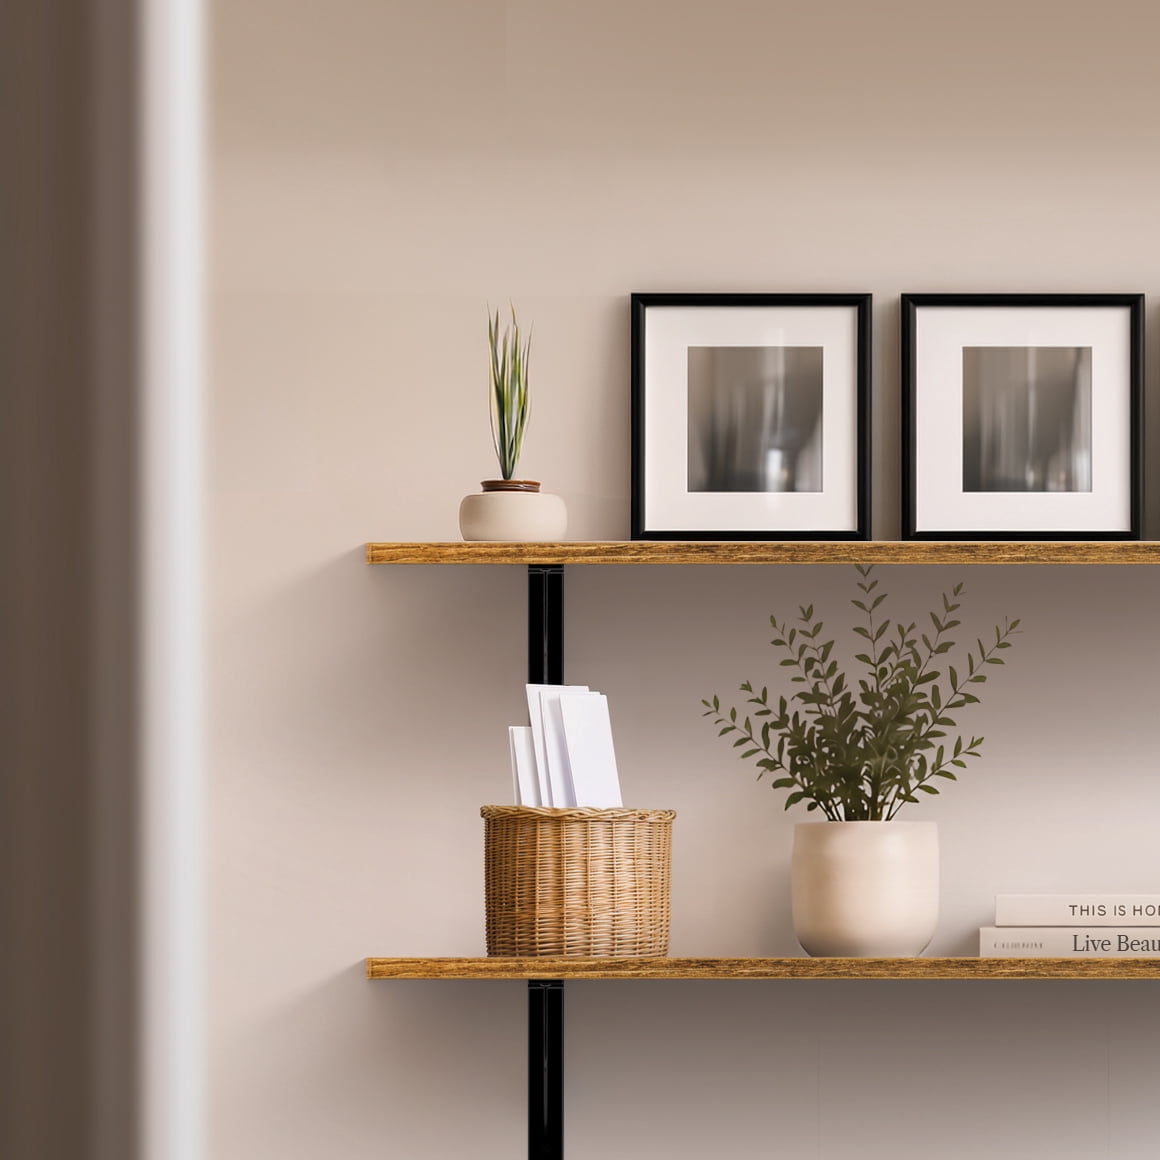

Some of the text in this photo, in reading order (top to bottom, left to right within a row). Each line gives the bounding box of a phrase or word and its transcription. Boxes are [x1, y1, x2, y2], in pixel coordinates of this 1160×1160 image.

[1068, 904, 1107, 917] THIS
[1113, 904, 1127, 917] IS
[1072, 934, 1111, 952] Live
